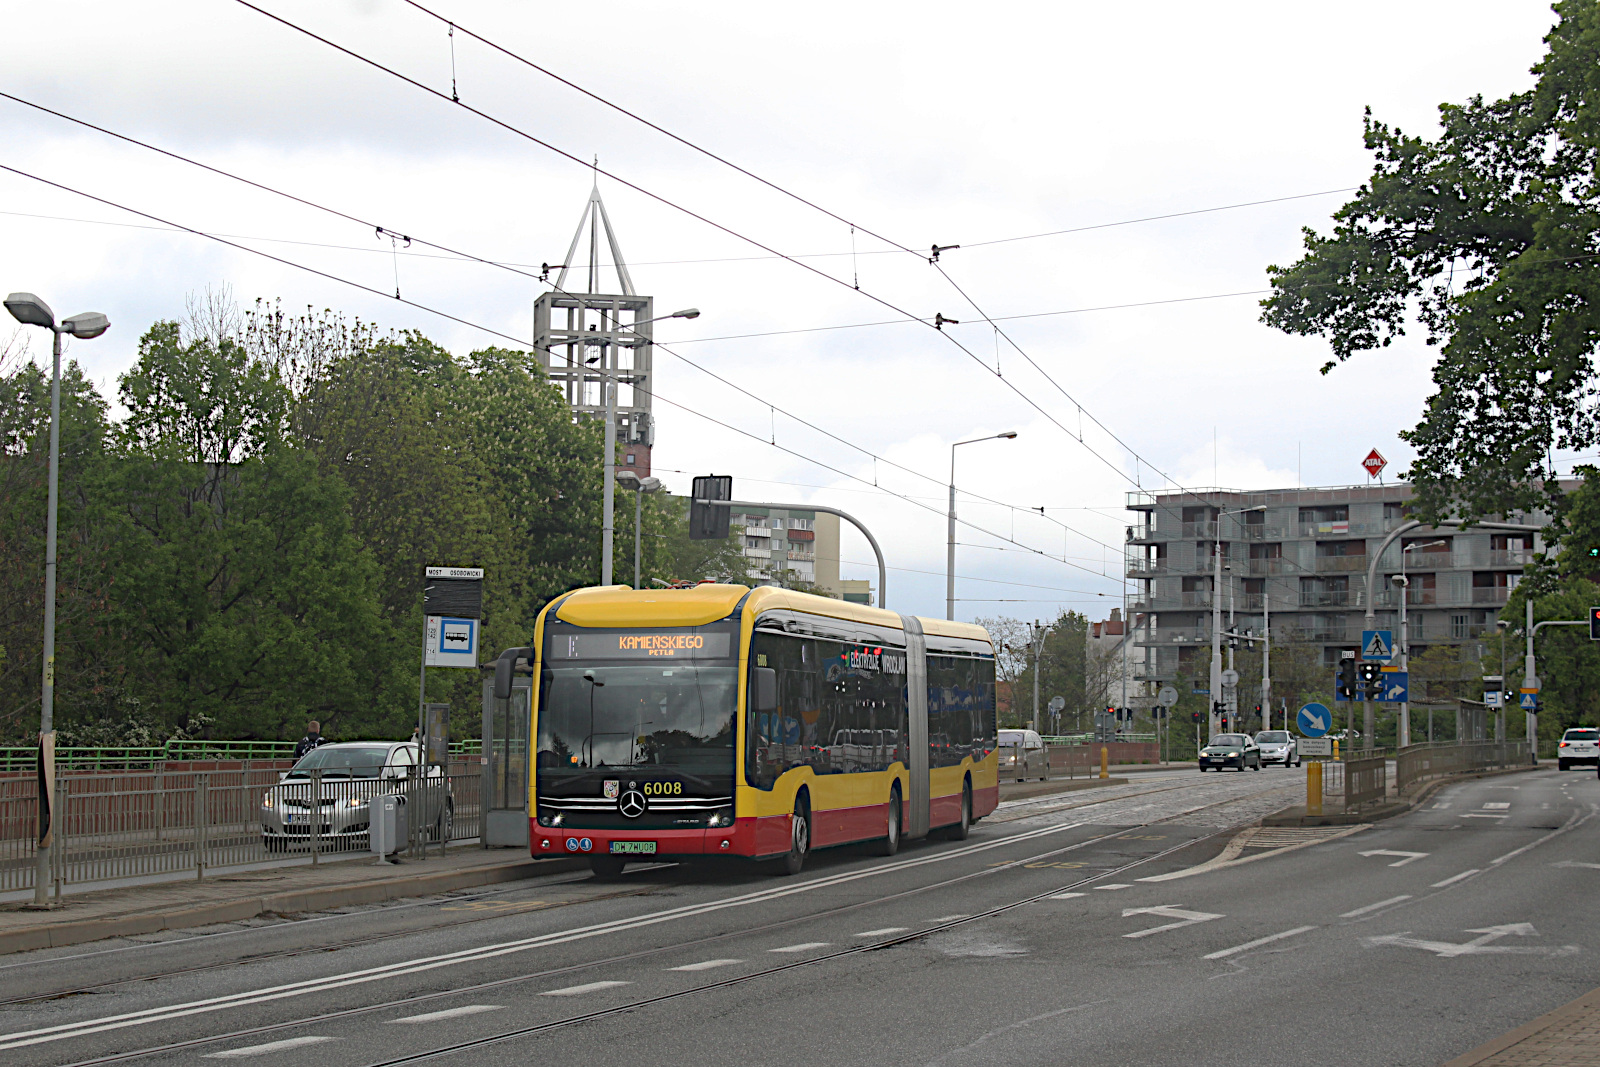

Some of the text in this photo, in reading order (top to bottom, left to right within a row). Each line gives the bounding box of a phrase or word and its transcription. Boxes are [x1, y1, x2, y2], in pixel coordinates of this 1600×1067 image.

[1365, 458, 1382, 466] ATAL
[568, 635, 704, 657] K KAMIEŃSKIEGO
[643, 781, 682, 795] 6008
